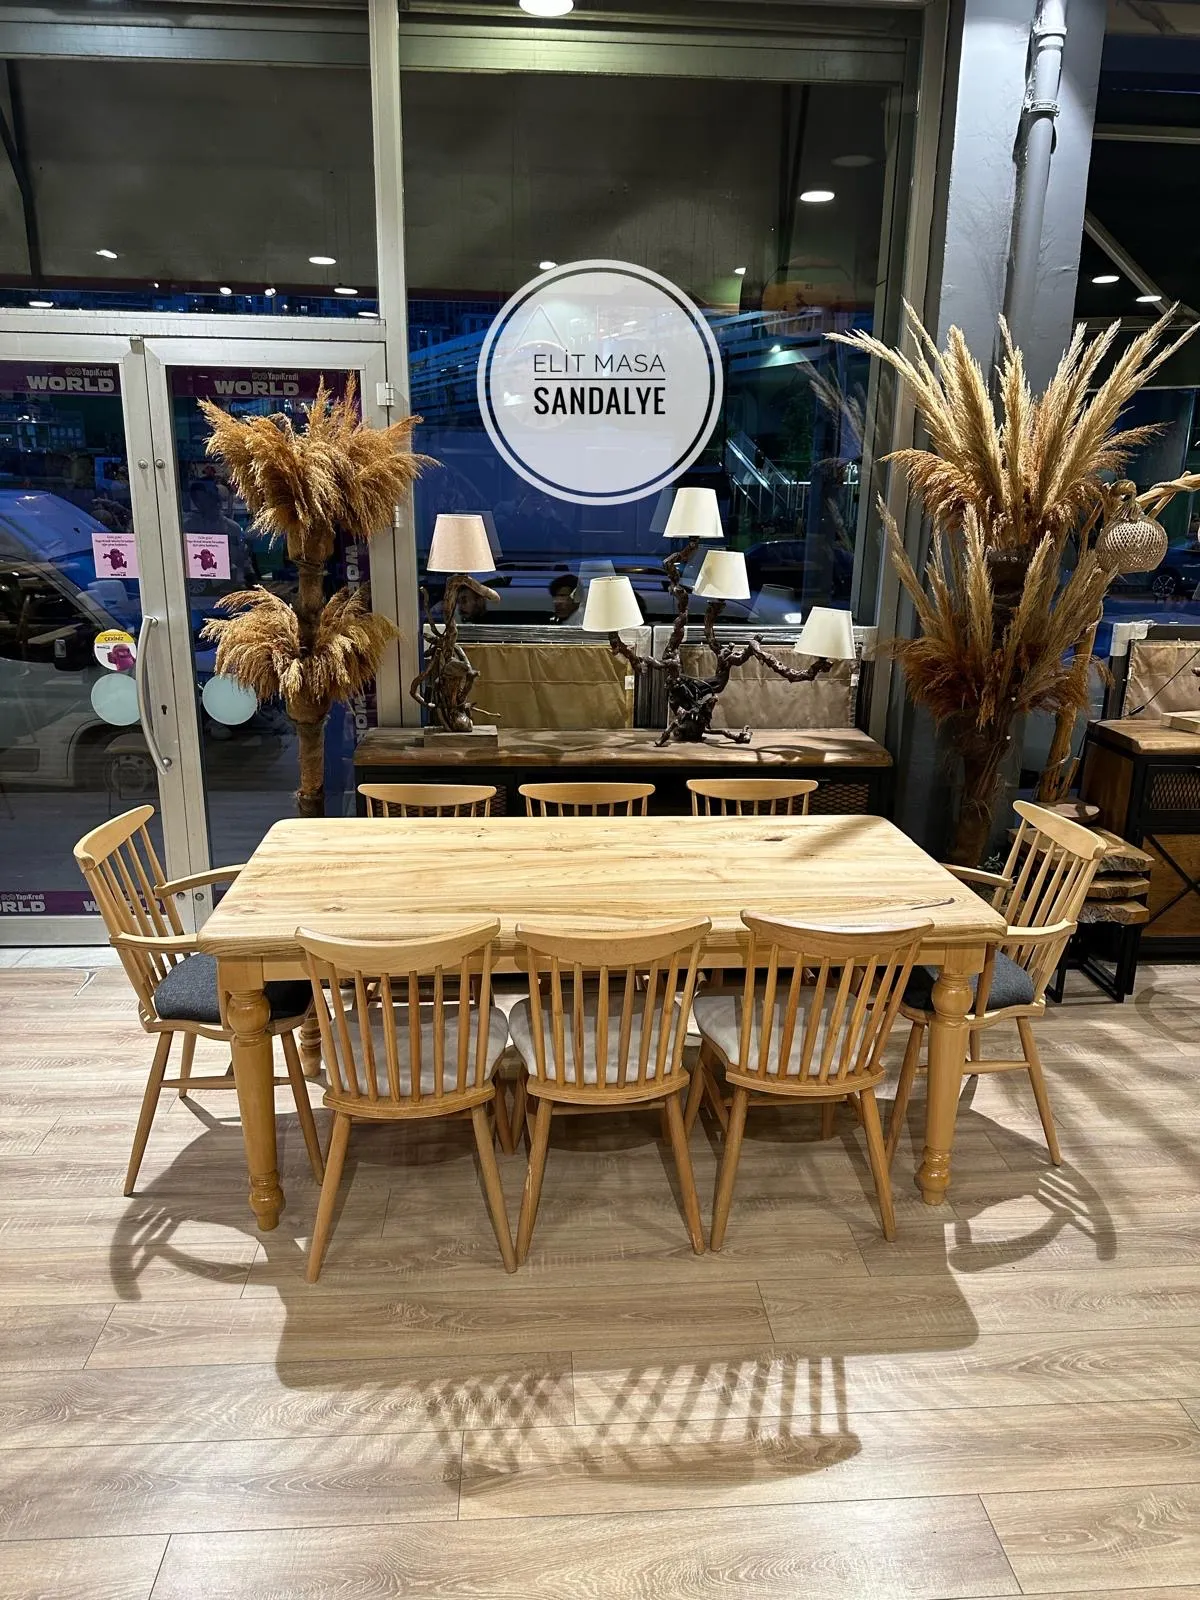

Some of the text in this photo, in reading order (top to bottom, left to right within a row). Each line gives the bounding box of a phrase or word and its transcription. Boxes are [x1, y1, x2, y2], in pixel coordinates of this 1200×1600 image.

[26, 375, 115, 393] WORLD
[214, 380, 300, 396] WORLD
[0, 901, 46, 913] RLD
